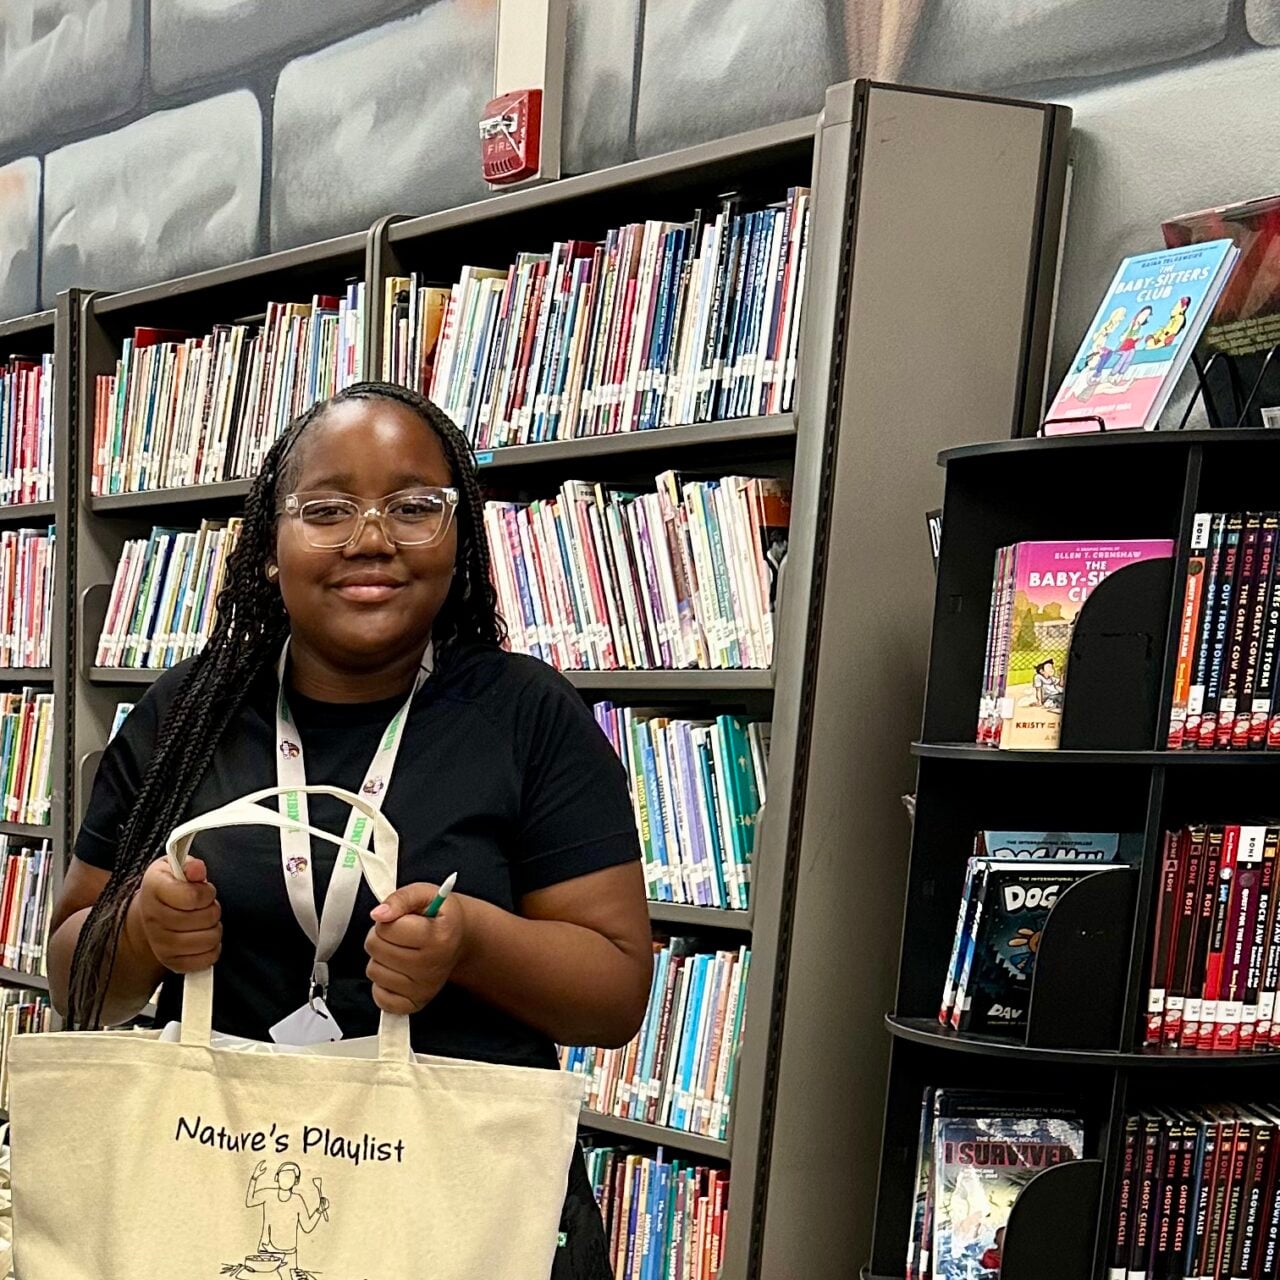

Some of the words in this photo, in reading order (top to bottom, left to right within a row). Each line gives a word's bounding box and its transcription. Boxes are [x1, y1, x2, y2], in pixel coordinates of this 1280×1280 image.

[487, 140, 513, 155] FIRE
[1116, 266, 1210, 294] BABY-SITTERS
[1136, 286, 1174, 302] CLUB
[1085, 561, 1107, 570] THE
[1093, 551, 1141, 559] CRENSHAW
[1260, 547, 1271, 575] BONE
[1222, 584, 1230, 606] OUT
[1239, 584, 1249, 604] THE
[1257, 581, 1266, 602] THE
[1217, 610, 1227, 640] FROM
[1235, 608, 1245, 641] GREAT
[1252, 605, 1263, 638] GREAT
[1270, 611, 1279, 625] OF
[1266, 628, 1276, 648] THE
[1231, 645, 1241, 670] COW
[1248, 641, 1258, 666] COW
[1208, 643, 1223, 698] BONEVILLE
[1243, 668, 1254, 694] RACE
[1260, 652, 1273, 687] STORM
[1004, 885, 1059, 912] DOG
[1184, 892, 1194, 916] ROSE
[1202, 893, 1212, 917] ROSE
[1258, 894, 1268, 921] ROCK
[1255, 924, 1265, 944] JAW
[175, 1116, 289, 1153] Nature's
[303, 1125, 405, 1166] Playlist
[944, 1142, 953, 1165] I
[1121, 1179, 1130, 1209] GHOST
[1141, 1180, 1151, 1210] GHOST
[1163, 1185, 1173, 1215] GHOST
[1178, 1185, 1188, 1215] GHOST
[1200, 1187, 1208, 1207] TALL
[1248, 1188, 1259, 1223] CROWN
[1228, 1186, 1240, 1231] TREASURE
[1118, 1211, 1127, 1246] CIRCLES
[1138, 1213, 1147, 1247] CIRCLES
[1159, 1218, 1169, 1251] CIRCLES
[1174, 1217, 1184, 1251] CIRCLES
[1196, 1210, 1206, 1235] TALES
[1246, 1225, 1253, 1237] OF
[1269, 1227, 1277, 1239] OF
[1222, 1233, 1233, 1274] HUNTERS
[1241, 1240, 1251, 1271] HORNS
[1264, 1241, 1275, 1273] HORNS
